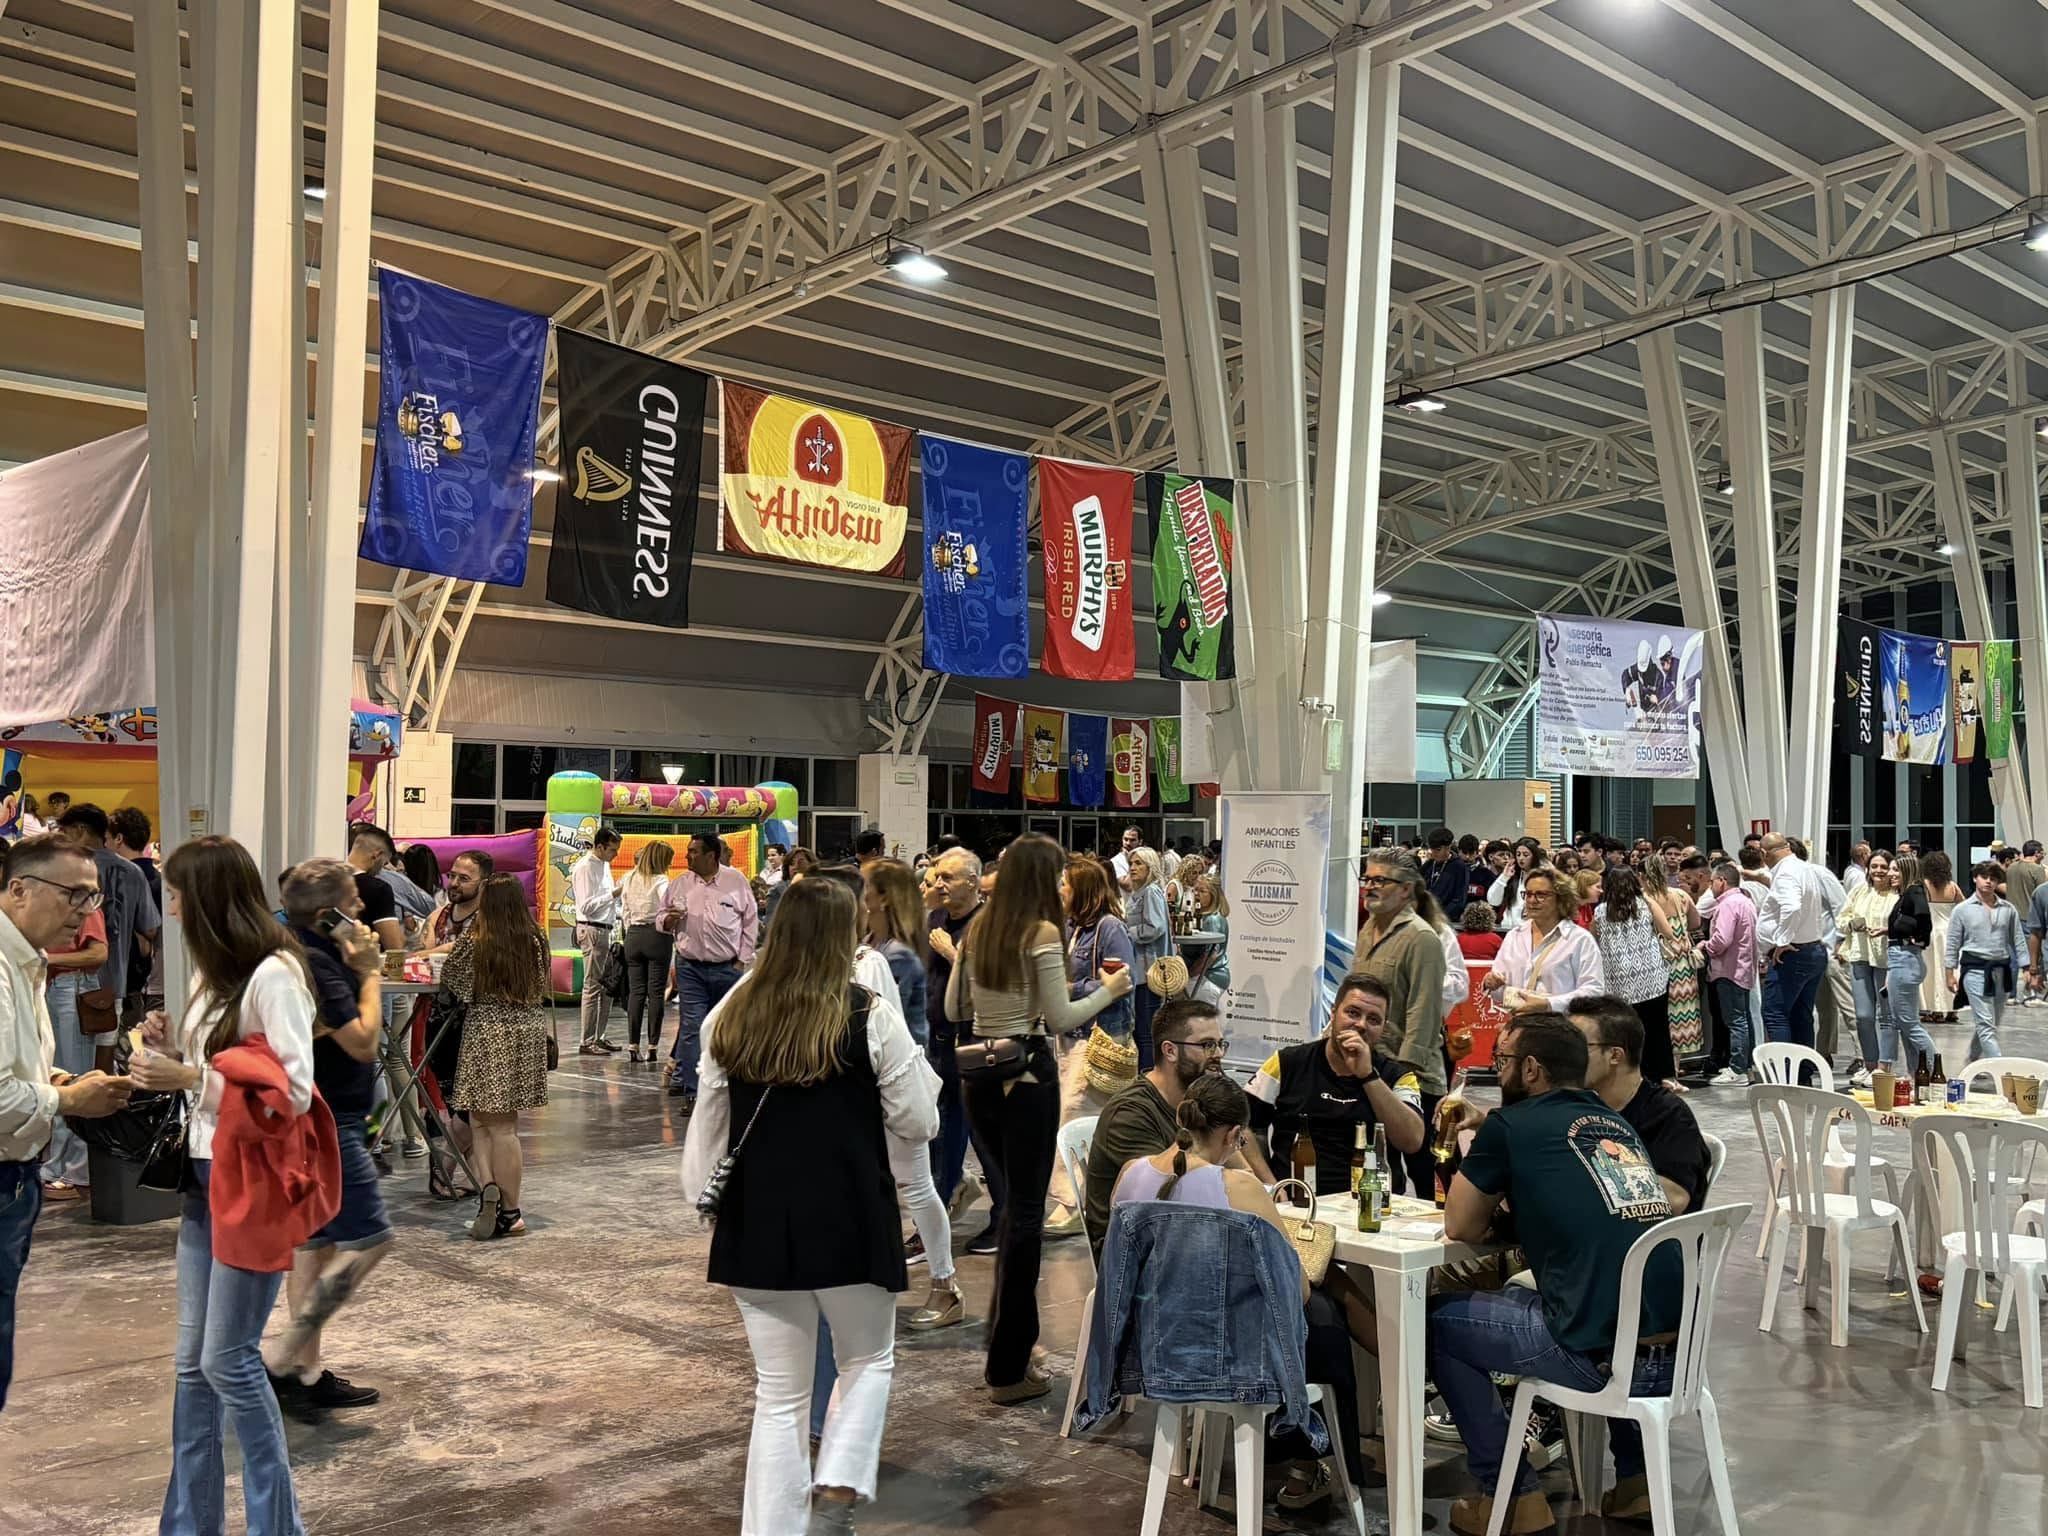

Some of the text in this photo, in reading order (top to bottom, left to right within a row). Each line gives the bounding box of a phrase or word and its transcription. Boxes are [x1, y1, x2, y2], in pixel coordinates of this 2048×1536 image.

[415, 391, 442, 467] Fischer
[946, 530, 967, 588] Fischer
[1062, 521, 1074, 618] IRISH RED
[1079, 510, 1103, 636] MURPHY'S
[1165, 492, 1179, 543] Tequila
[1191, 607, 1204, 637] Beer
[1176, 481, 1227, 628] DESPERADOS
[1567, 642, 1612, 659] Energética
[1636, 746, 1689, 762] 650 095 254
[1245, 827, 1301, 837] ANIMACIONES
[1250, 840, 1296, 849] INFANTILES
[1407, 1275, 1423, 1300] 42
